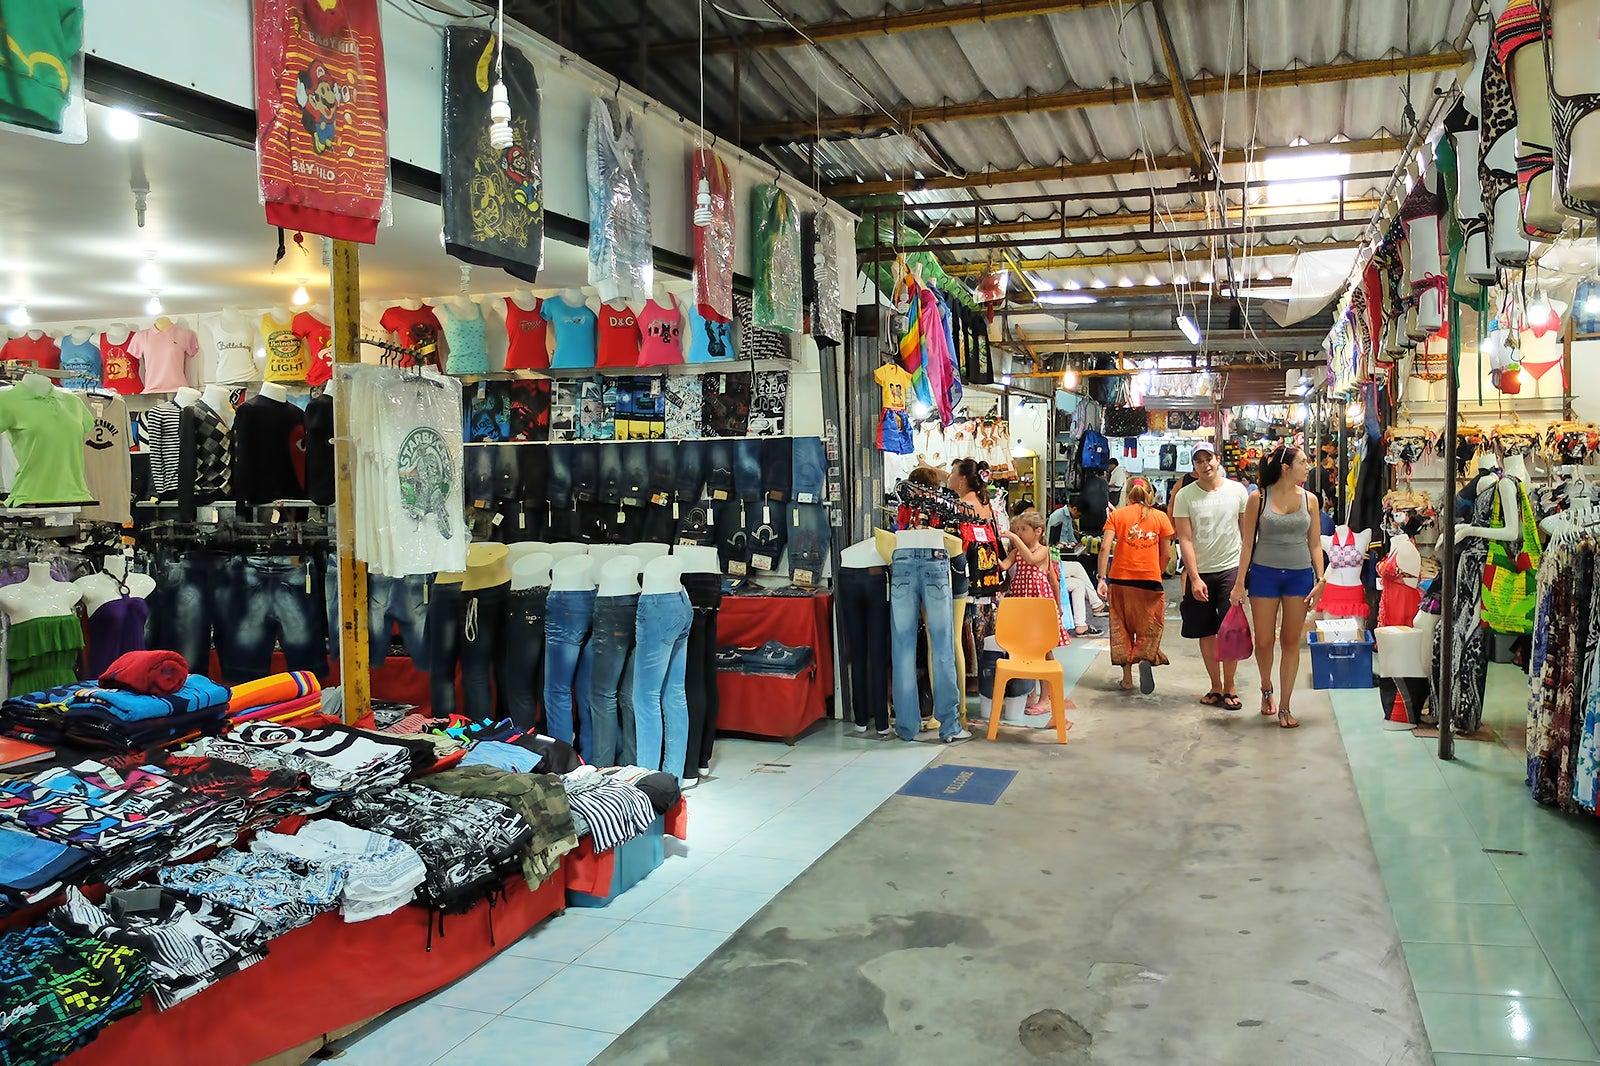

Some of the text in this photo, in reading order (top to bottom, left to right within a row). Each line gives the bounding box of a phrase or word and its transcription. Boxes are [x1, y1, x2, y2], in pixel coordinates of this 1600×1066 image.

[609, 316, 634, 327] D&G
[271, 362, 304, 372] LIGHT
[95, 428, 103, 442] 2
